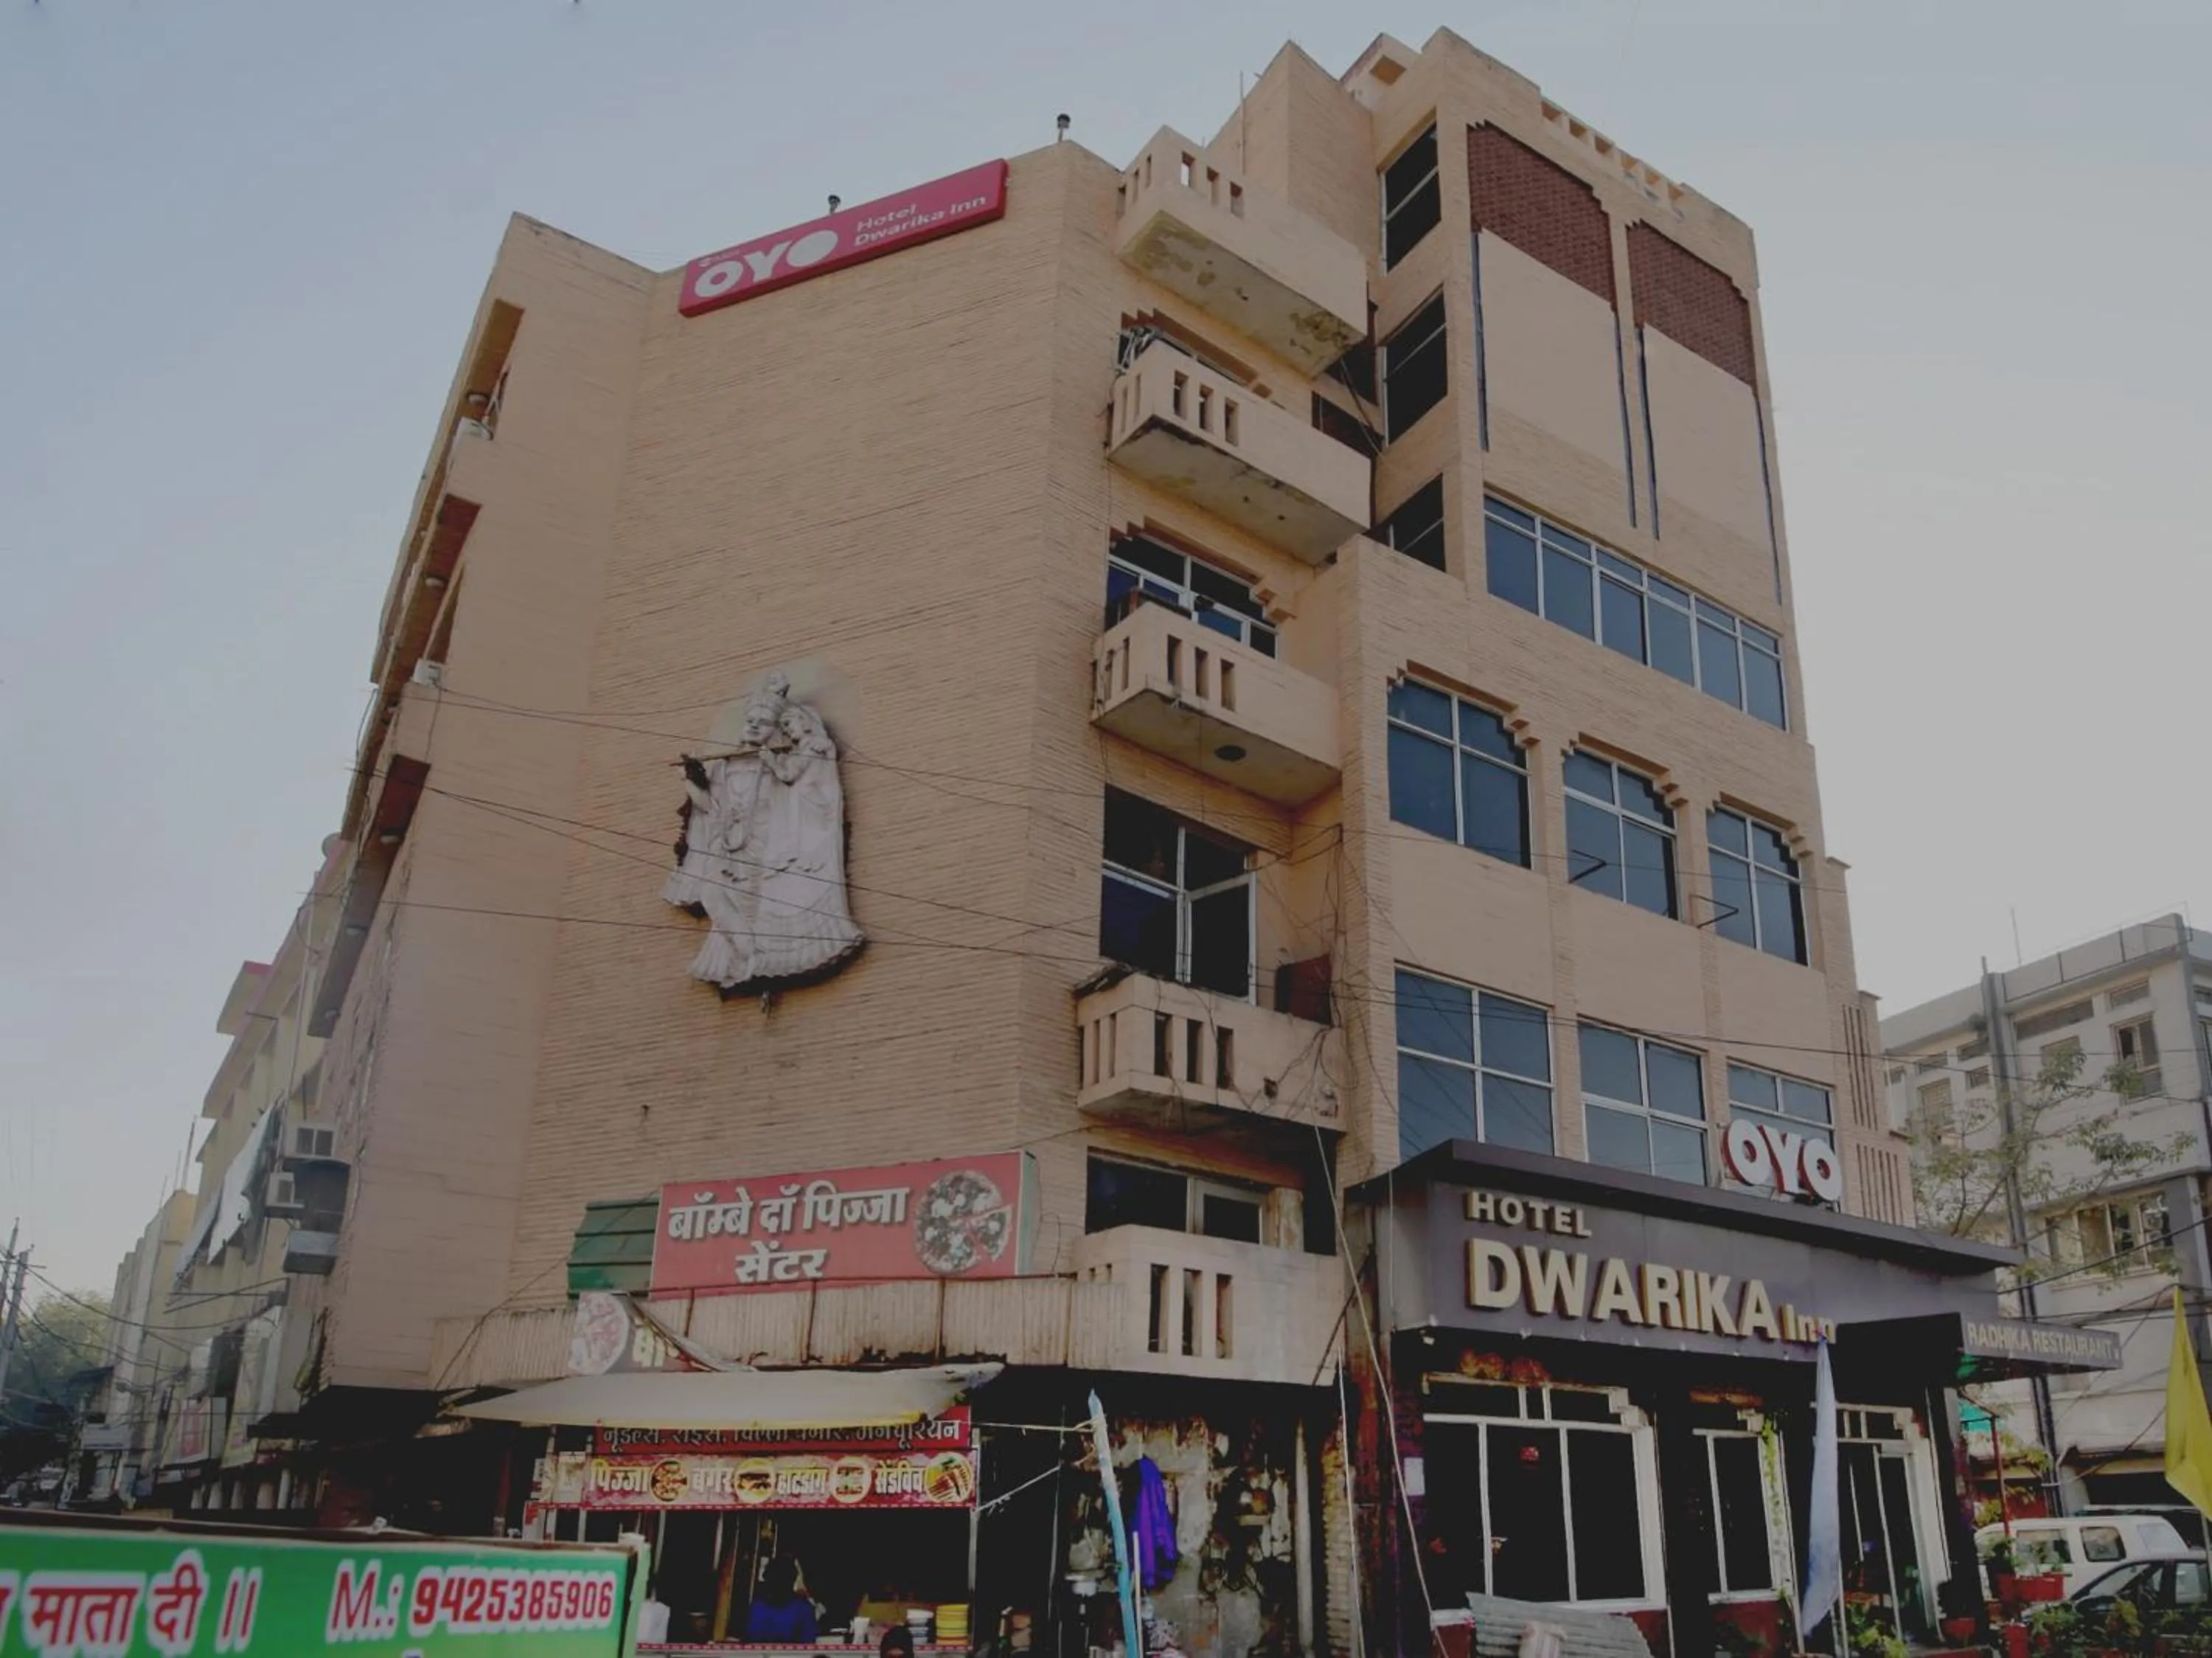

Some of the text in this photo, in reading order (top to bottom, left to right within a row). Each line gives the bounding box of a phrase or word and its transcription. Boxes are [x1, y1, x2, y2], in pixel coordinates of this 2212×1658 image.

[854, 196, 987, 246] Dwarika Inn
[856, 204, 917, 232] Hotel
[694, 229, 838, 297] OYO
[1722, 1118, 1842, 1202] OYO
[802, 1180, 911, 1230] पिज्जा
[1467, 1190, 1593, 1238] HOTEL
[734, 1241, 827, 1284] सेंटर
[1466, 1238, 1836, 1345] DWARIKA Inn
[1966, 1321, 2113, 1360] RADHIKA RESTAURANT
[29, 1586, 139, 1645] माता
[153, 1561, 203, 1643] दी
[412, 1577, 613, 1626] 9425385906
